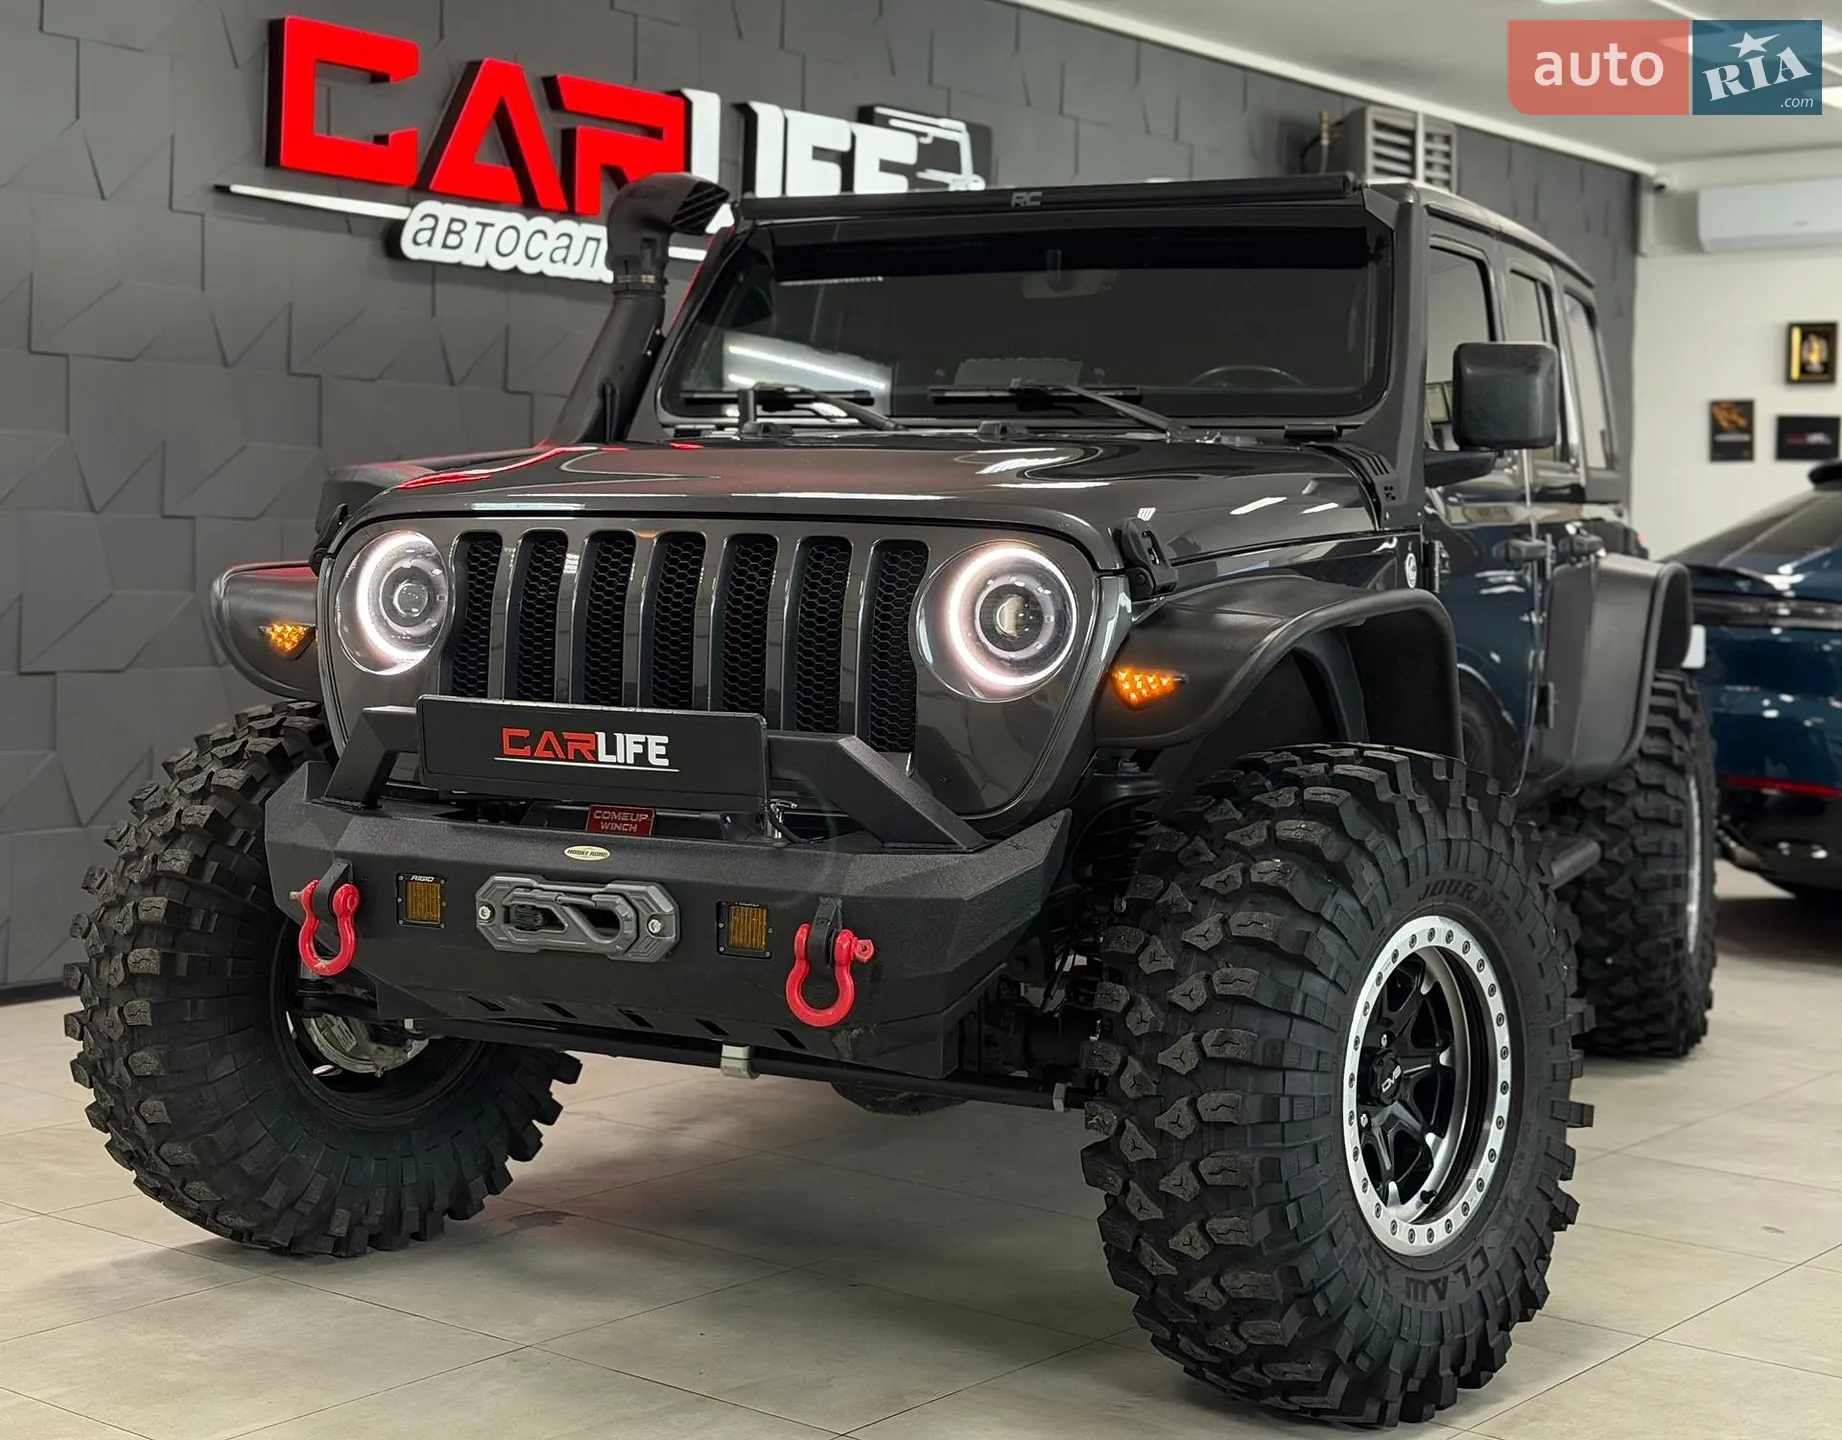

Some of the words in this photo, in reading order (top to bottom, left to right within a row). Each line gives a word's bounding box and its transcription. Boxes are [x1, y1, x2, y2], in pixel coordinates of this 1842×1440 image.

[411, 211, 602, 268] автосал
[502, 727, 670, 766] CARLIFE
[593, 810, 649, 822] COMEUP
[600, 821, 638, 832] WINCH
